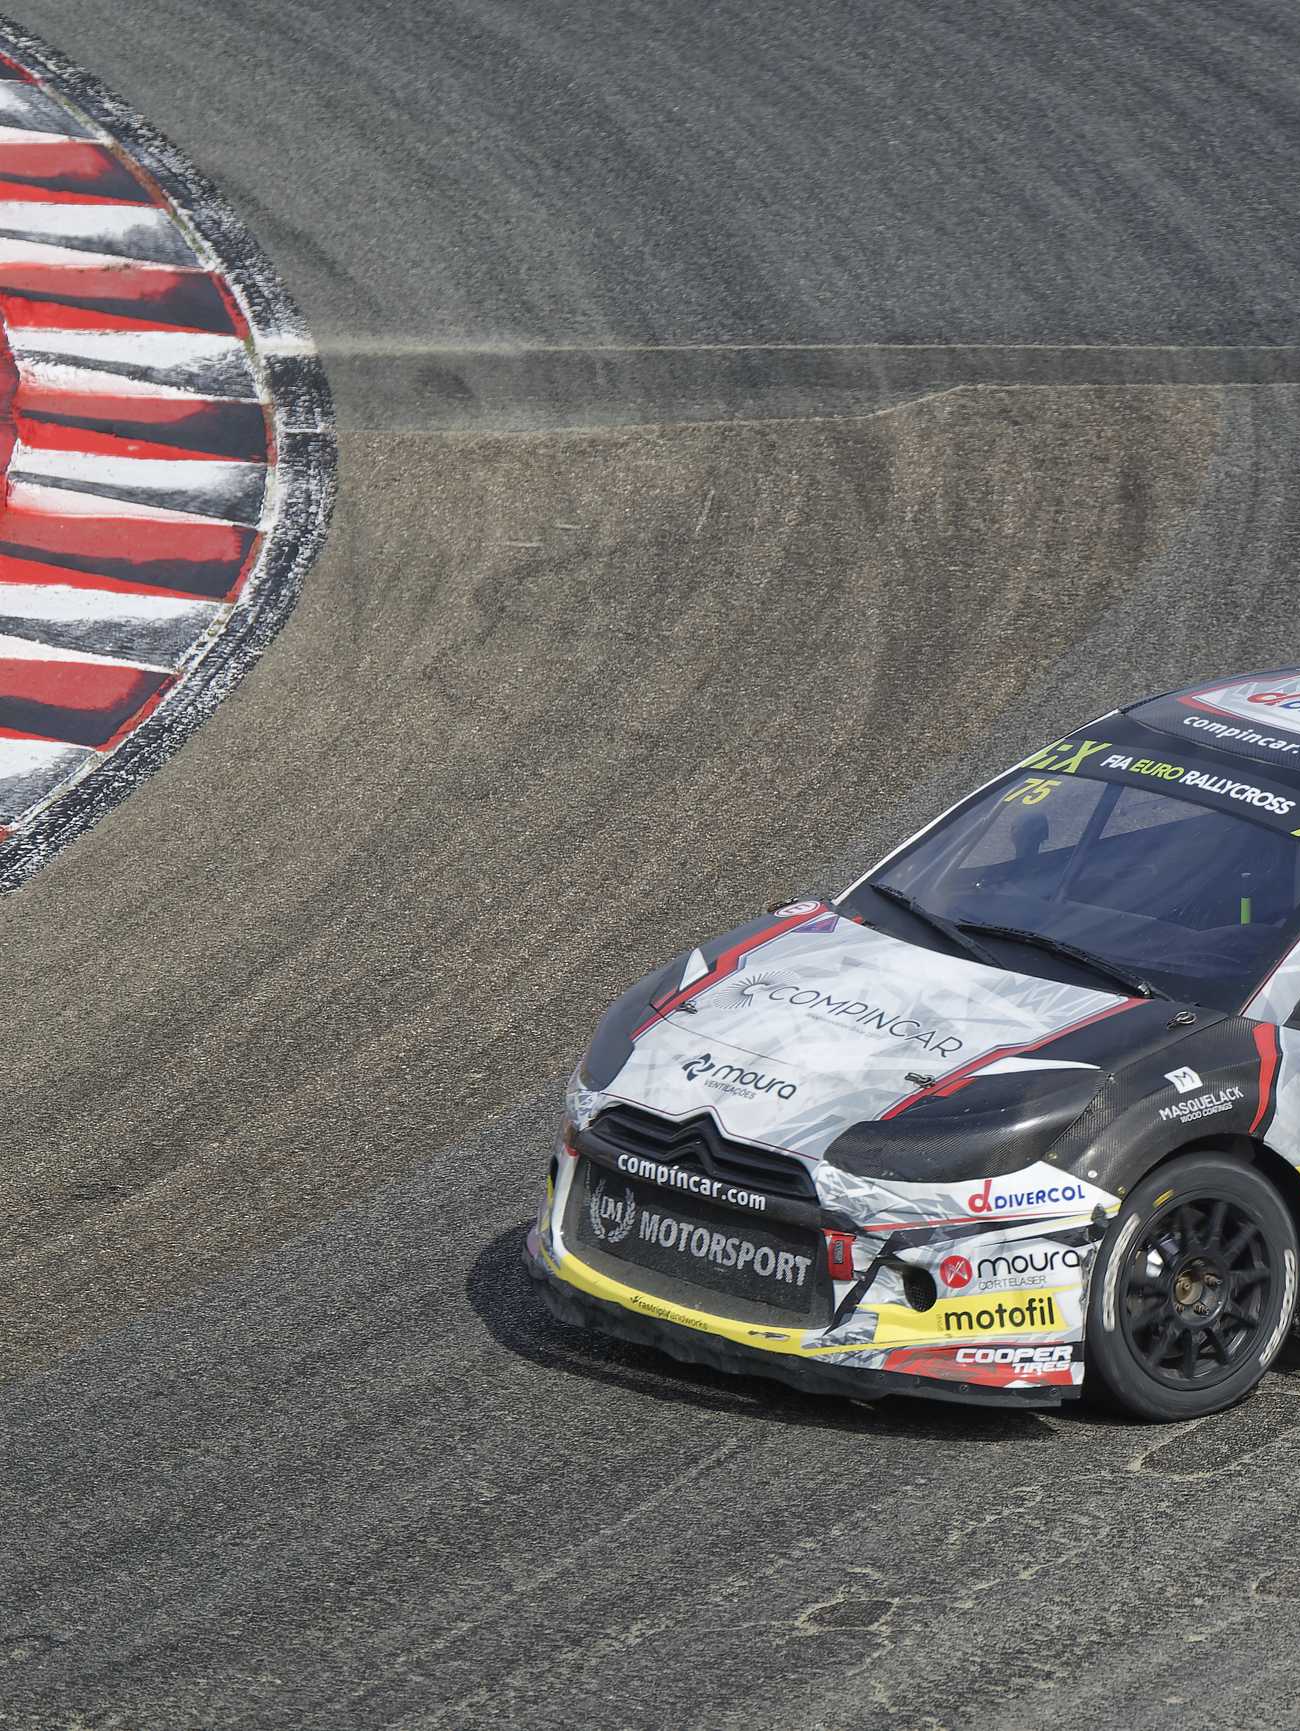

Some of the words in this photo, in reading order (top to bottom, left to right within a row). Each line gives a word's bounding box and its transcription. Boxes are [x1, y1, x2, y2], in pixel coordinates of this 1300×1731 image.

[1004, 777, 1063, 805] 75
[1100, 754, 1134, 771] FIA
[1128, 758, 1185, 781] EURO
[1179, 770, 1297, 816] RALLYCROSS
[767, 985, 963, 1059] COMPINCAR
[711, 1064, 797, 1100] moura
[1158, 1086, 1245, 1121] MASQUELACK
[616, 1153, 767, 1211] compincar.com
[994, 1184, 1086, 1210] DIVERCOL
[638, 1210, 813, 1287] MOTORSPORT
[977, 1249, 1080, 1279] moura
[944, 1296, 1055, 1331] motofil
[954, 1344, 1074, 1364] COOPER
[1012, 1361, 1071, 1375] TIRES
